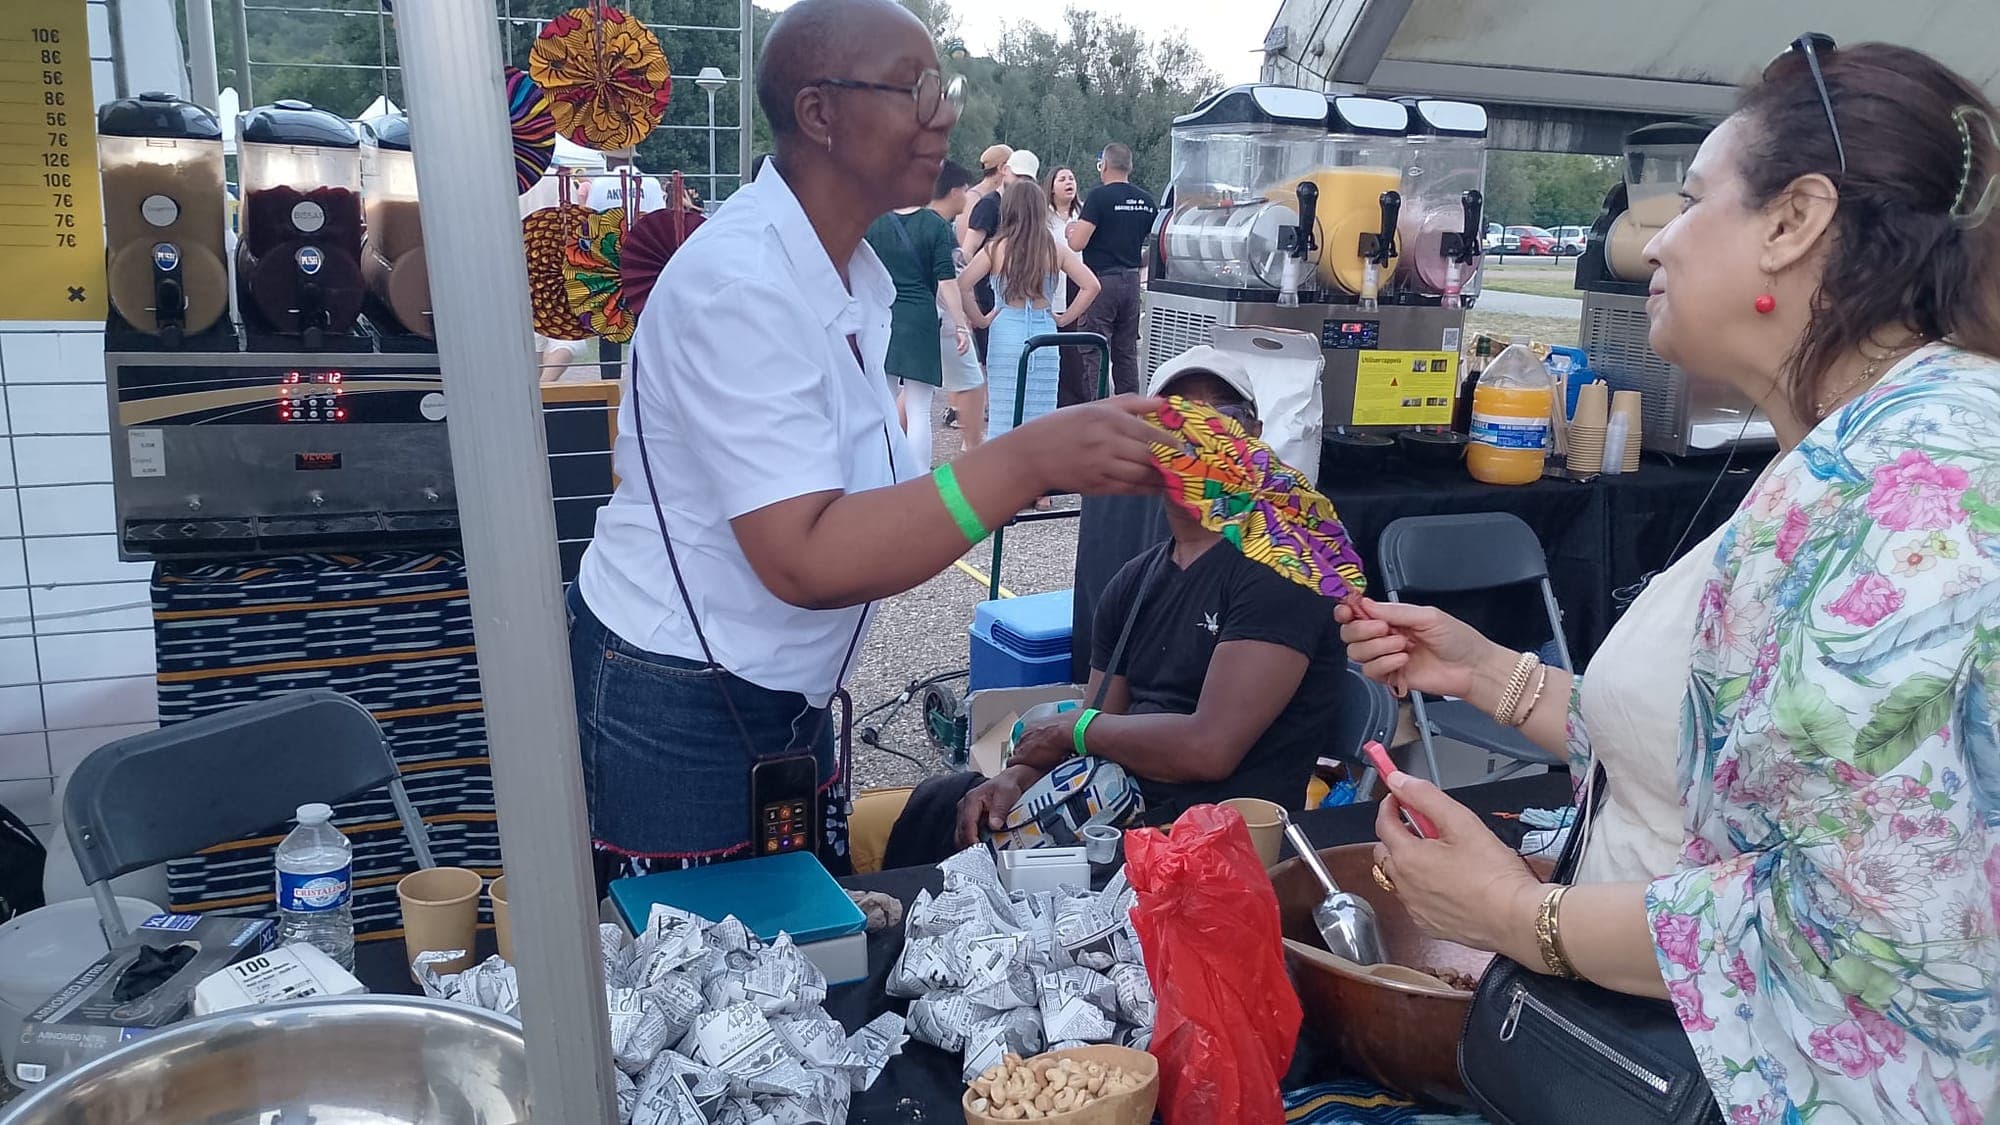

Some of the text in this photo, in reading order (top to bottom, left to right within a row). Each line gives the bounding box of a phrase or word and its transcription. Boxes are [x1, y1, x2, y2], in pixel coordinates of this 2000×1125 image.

[32, 28, 60, 43] 10€
[41, 49, 61, 64] 8€
[43, 70, 63, 85] 5€
[44, 91, 65, 106] 8€
[46, 112, 67, 127] 5€
[48, 132, 68, 147] 7€
[41, 153, 70, 167] 12€
[43, 173, 72, 188] 10€
[53, 194, 73, 208] 7€
[54, 214, 75, 228] 7€
[56, 233, 77, 248] 7€
[157, 252, 175, 262] PUSH
[301, 255, 318, 265] PUSH
[262, 929, 273, 946] XL
[235, 957, 270, 977] 100
